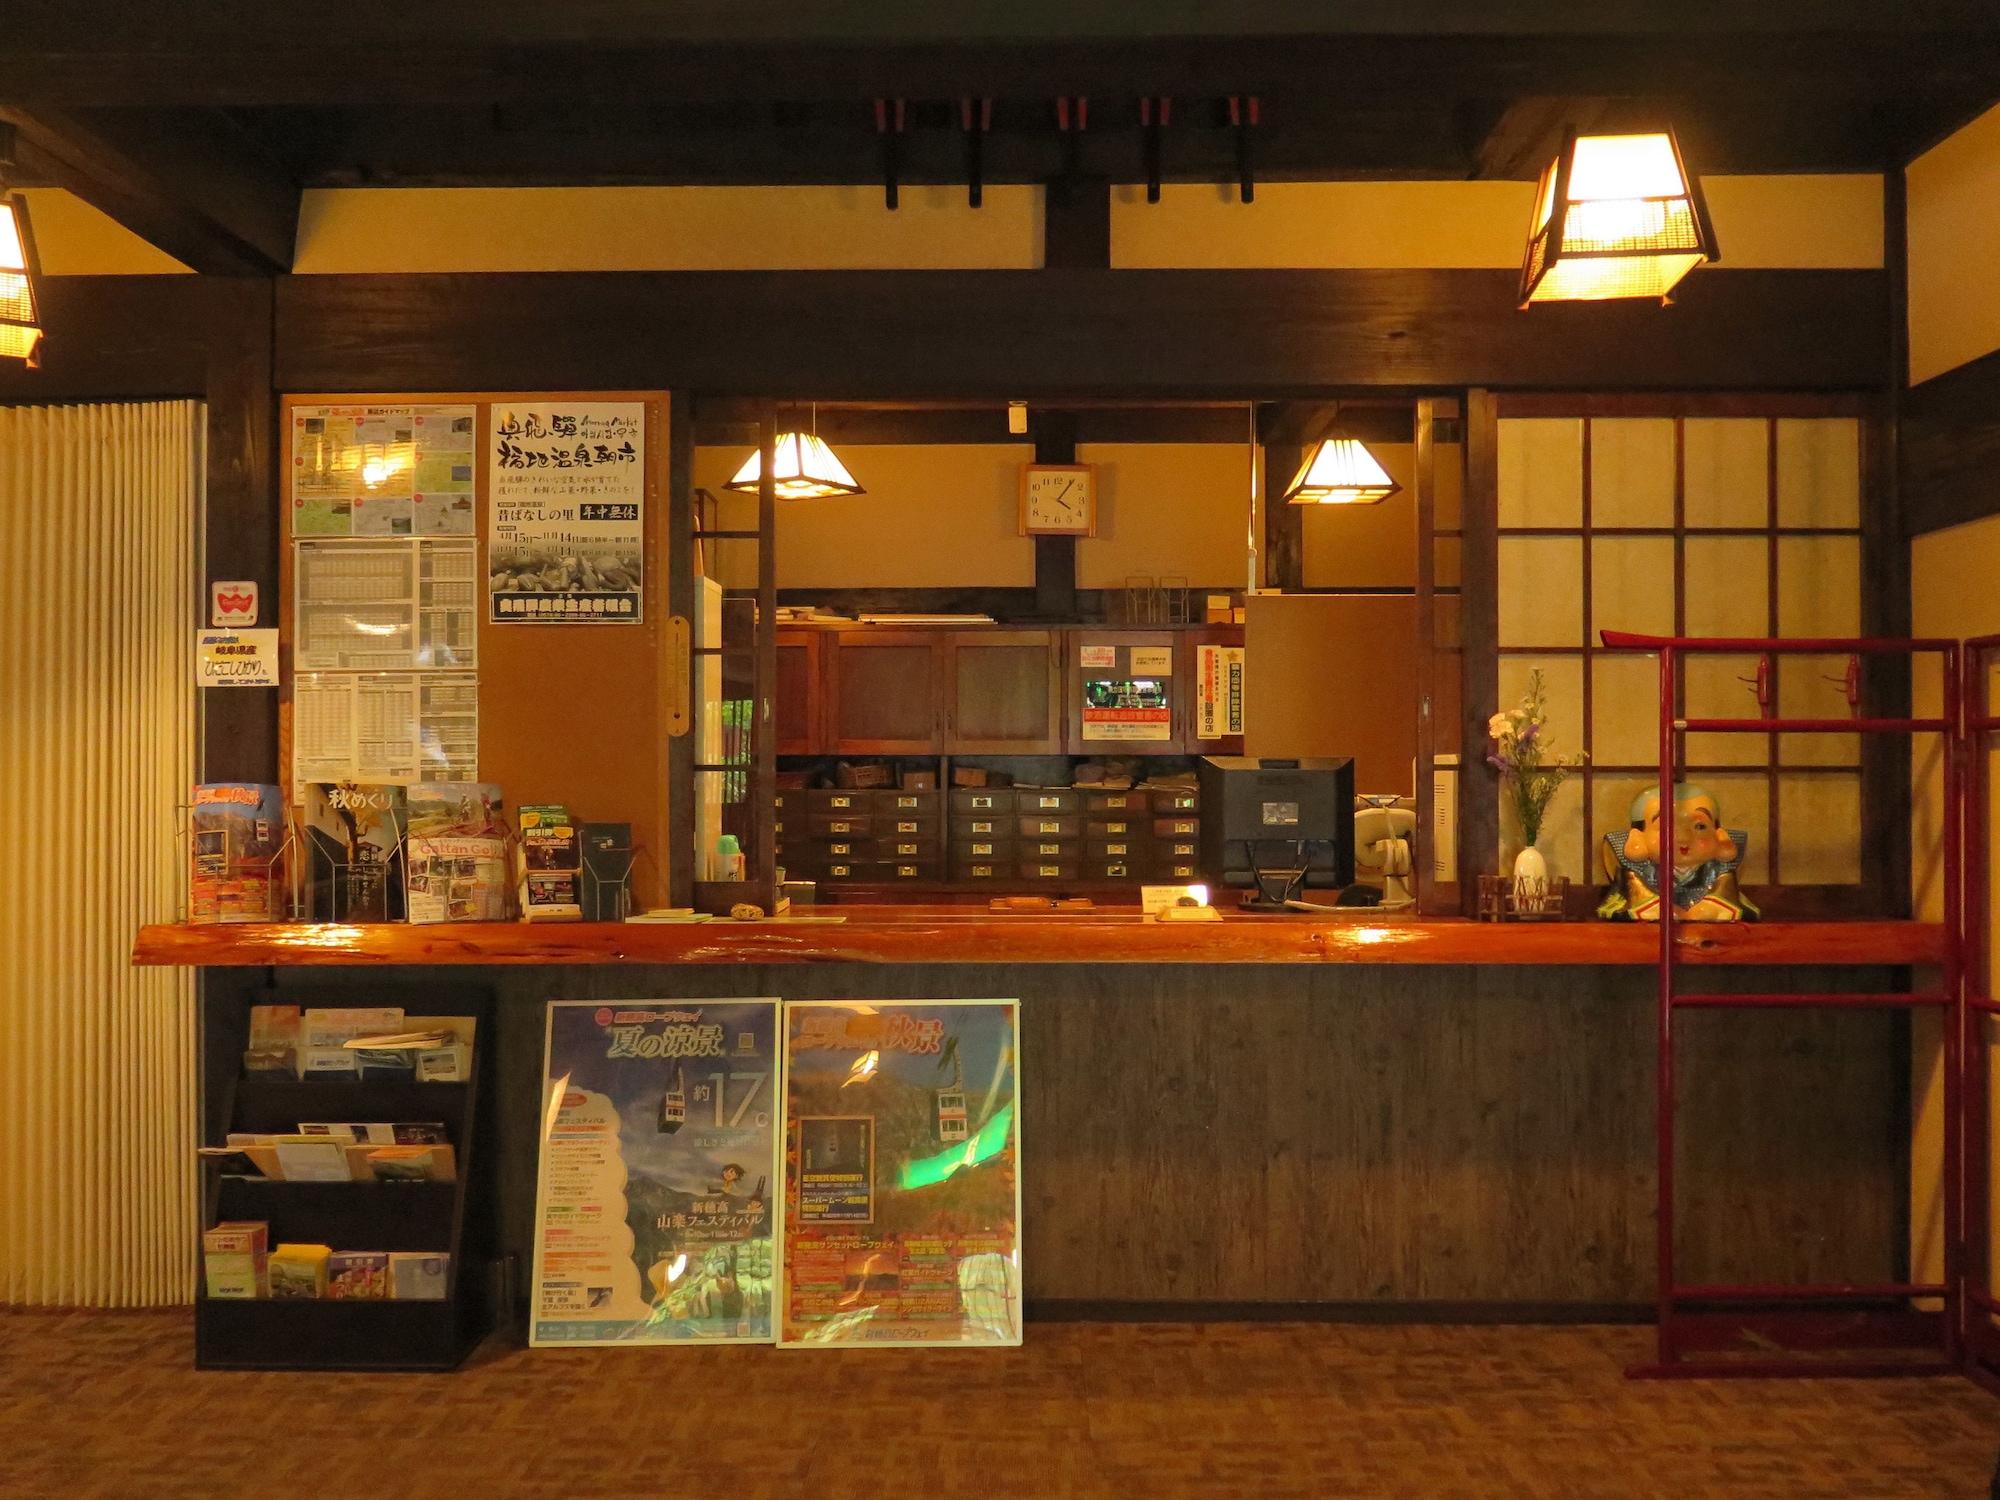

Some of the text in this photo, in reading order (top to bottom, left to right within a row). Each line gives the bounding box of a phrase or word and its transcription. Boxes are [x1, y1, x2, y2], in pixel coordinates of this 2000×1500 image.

[498, 508, 575, 522] 昔ばなしの里
[584, 506, 637, 520] 年中無休
